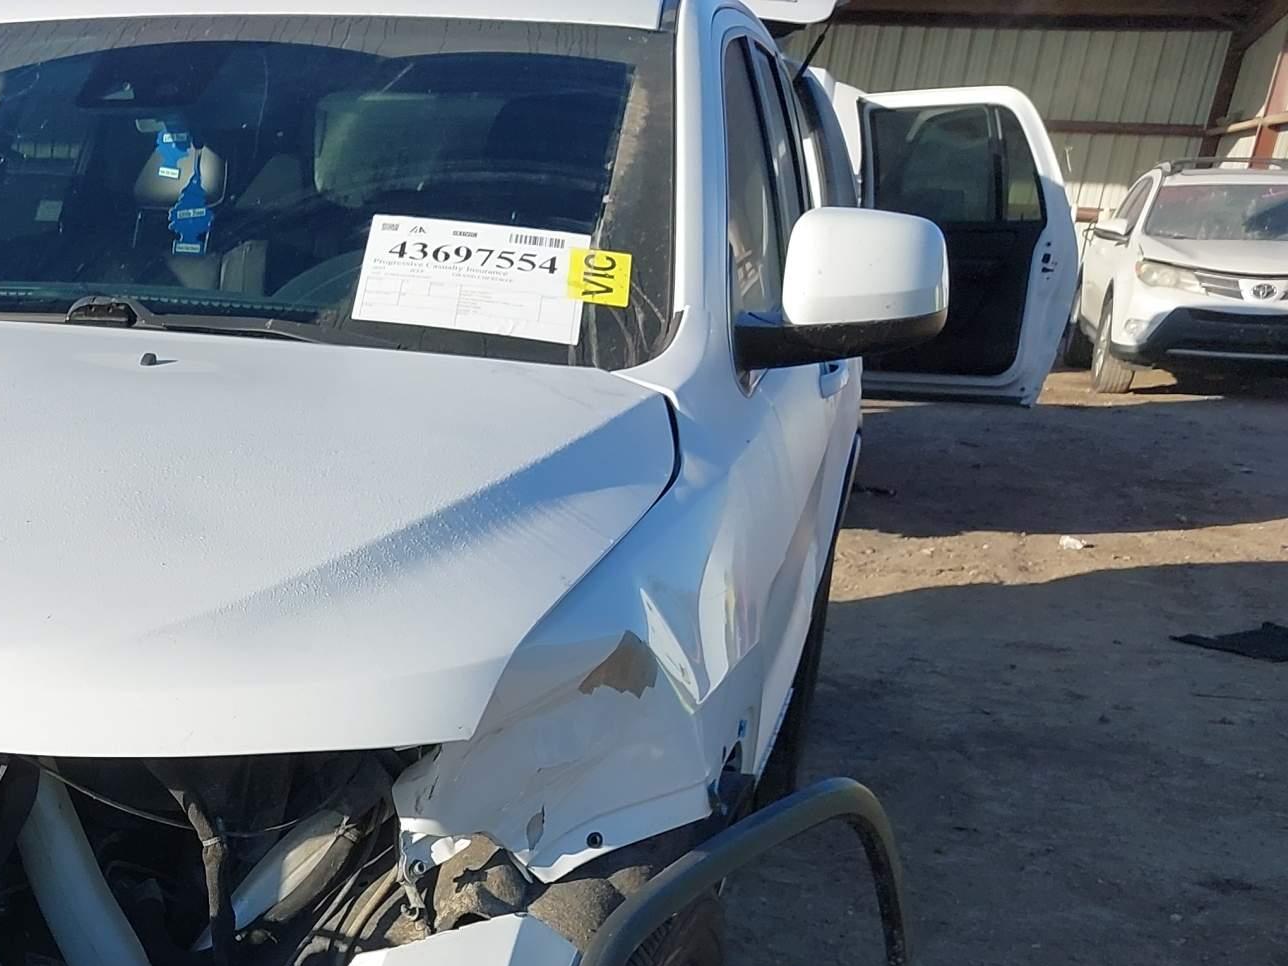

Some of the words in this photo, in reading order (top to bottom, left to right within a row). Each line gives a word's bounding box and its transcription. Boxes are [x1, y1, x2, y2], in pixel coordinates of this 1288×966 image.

[373, 257, 425, 268] Progressive
[466, 264, 509, 277] Insurance
[388, 240, 558, 275] 43697554
[581, 254, 617, 297] VIC
